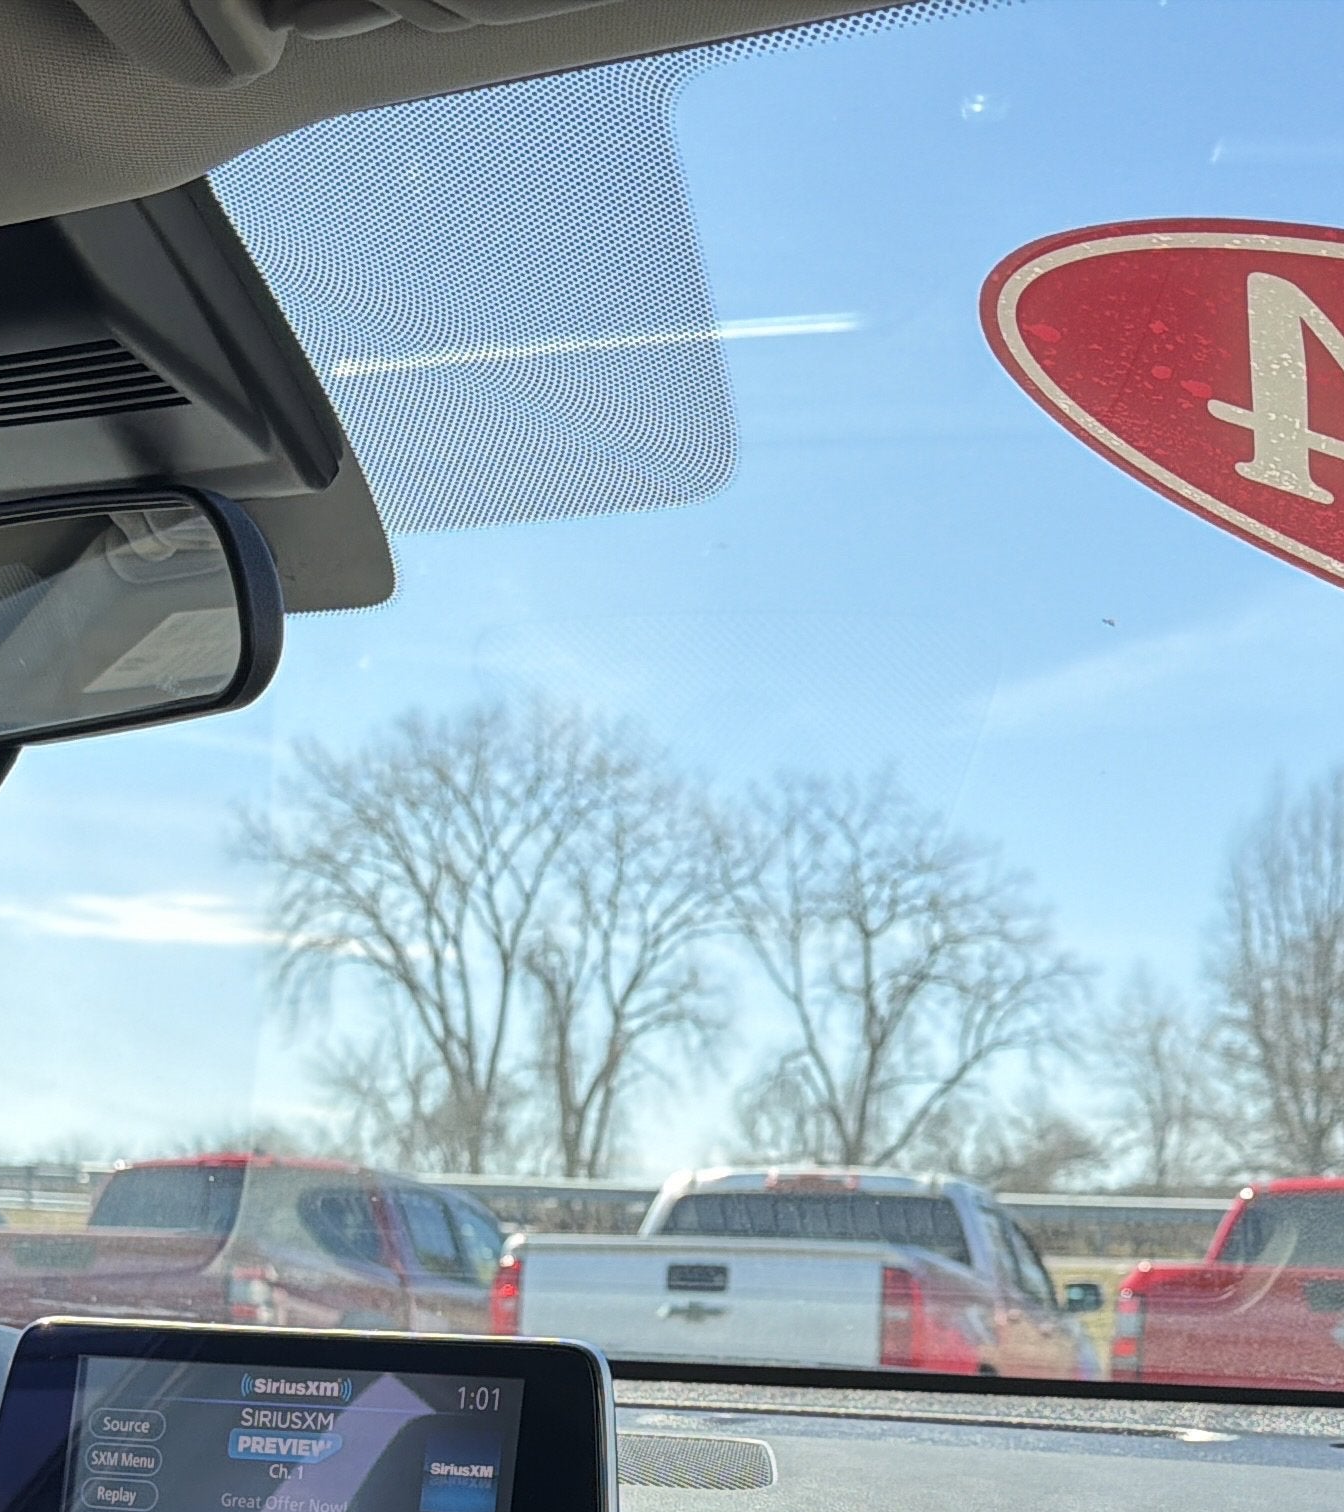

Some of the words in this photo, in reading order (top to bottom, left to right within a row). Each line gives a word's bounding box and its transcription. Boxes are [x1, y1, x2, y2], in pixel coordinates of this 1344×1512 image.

[457, 1386, 500, 1411] 1:01
[103, 1416, 150, 1434] Source
[240, 1407, 335, 1432] SIRIUSXM
[237, 1435, 333, 1458] PREVIEW
[91, 1450, 118, 1466] SXM
[120, 1452, 155, 1469] Menu
[269, 1463, 292, 1479] Ch.
[297, 1465, 304, 1480] 1
[430, 1461, 494, 1479] SiriusXM
[96, 1486, 136, 1505] Replay
[221, 1493, 261, 1509] Great
[265, 1495, 306, 1512] Offer
